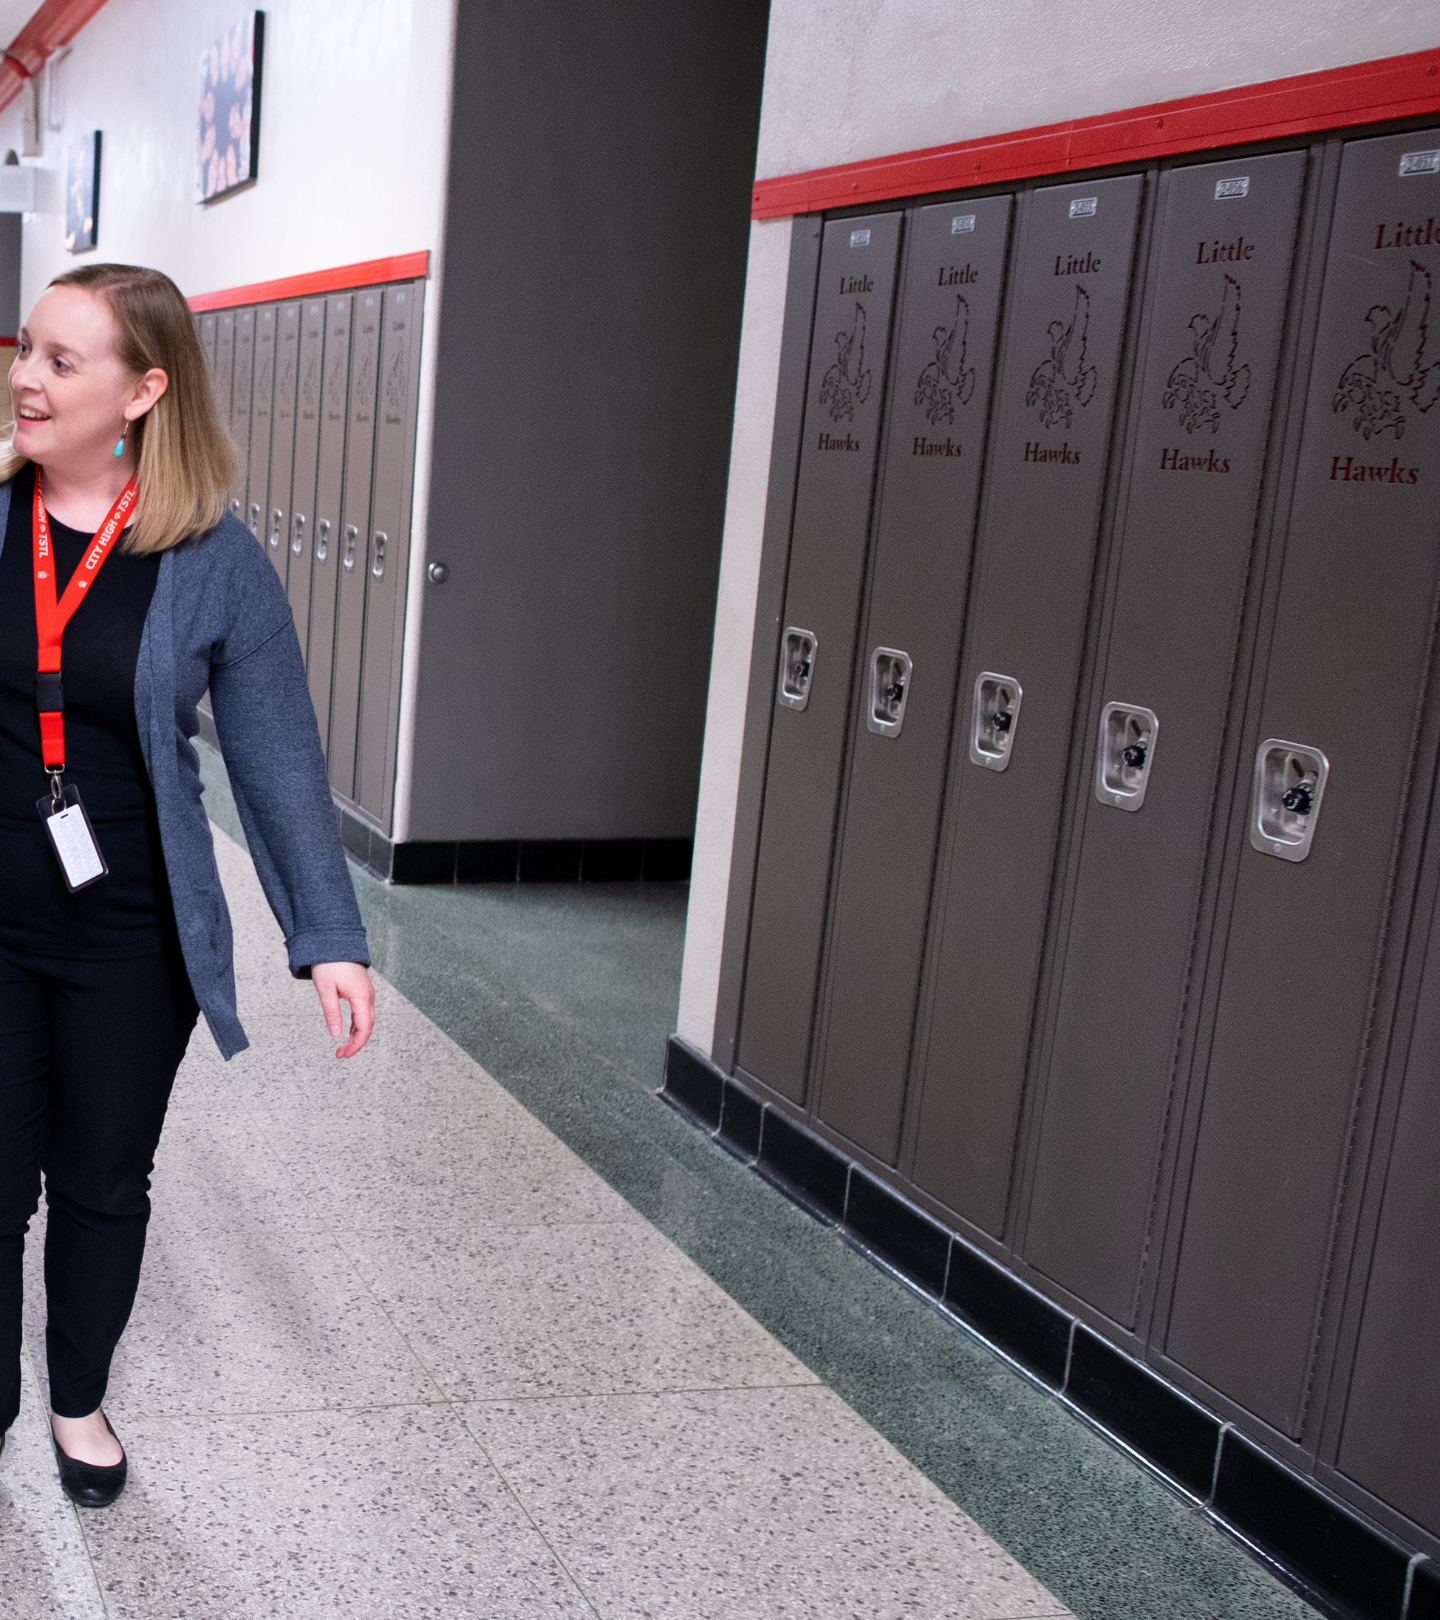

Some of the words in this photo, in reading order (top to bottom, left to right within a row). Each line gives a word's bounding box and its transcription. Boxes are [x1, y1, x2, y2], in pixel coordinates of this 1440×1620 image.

[1196, 236, 1255, 264] Little
[937, 263, 978, 286] Little
[1053, 251, 1101, 276] Little
[839, 274, 874, 294] Little
[818, 433, 860, 452] Hawks
[913, 437, 962, 457] Hawks
[1023, 442, 1081, 465] Hawks
[1159, 448, 1232, 474] Hawks
[1329, 456, 1420, 485] Hawks
[85, 545, 103, 570] CITY
[98, 518, 118, 547] HIGH
[116, 489, 136, 513] TSTL
[38, 533, 49, 558] TSTL
